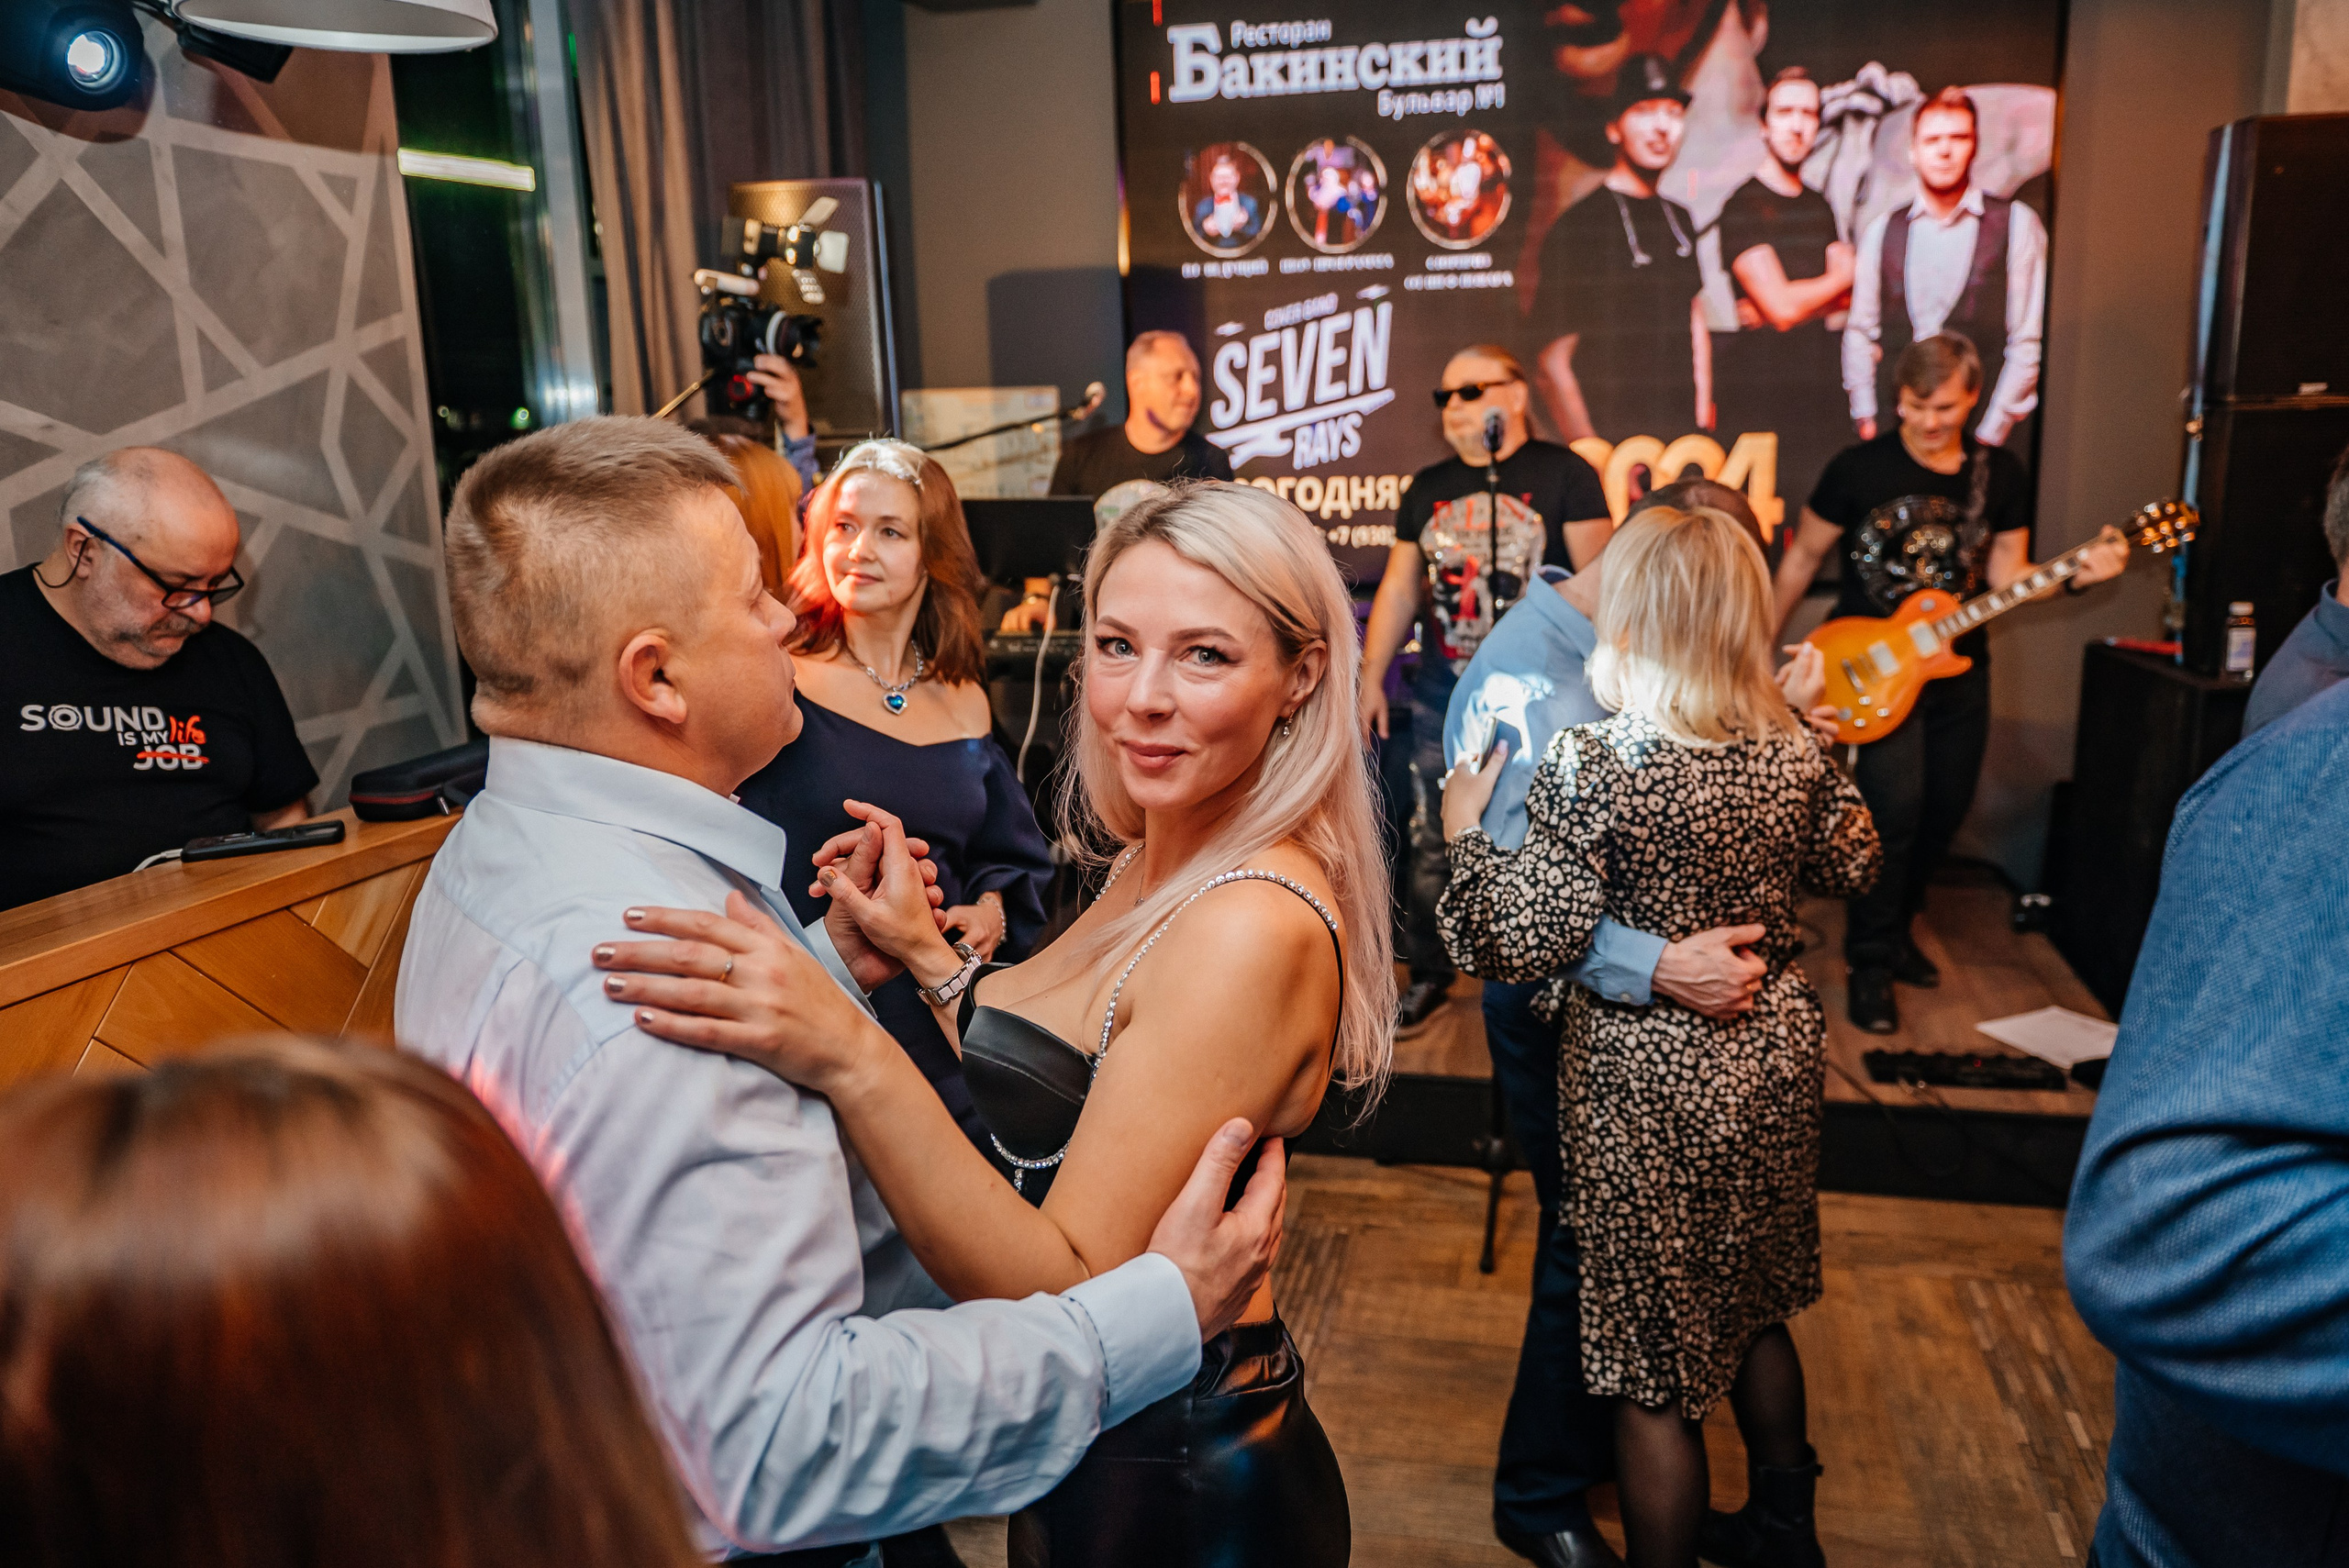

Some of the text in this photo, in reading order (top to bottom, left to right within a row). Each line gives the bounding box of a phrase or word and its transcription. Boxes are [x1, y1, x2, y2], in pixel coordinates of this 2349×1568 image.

[1230, 19, 1332, 49] Ресторан
[1167, 16, 1503, 103] Бакинский
[1377, 89, 1474, 120] Бульвар
[1209, 301, 1394, 429] SEVEN
[1293, 412, 1364, 471] RAYS
[20, 704, 167, 732] SOUND
[118, 732, 137, 747] IS
[141, 730, 169, 745] MY
[133, 744, 205, 771] JOB
